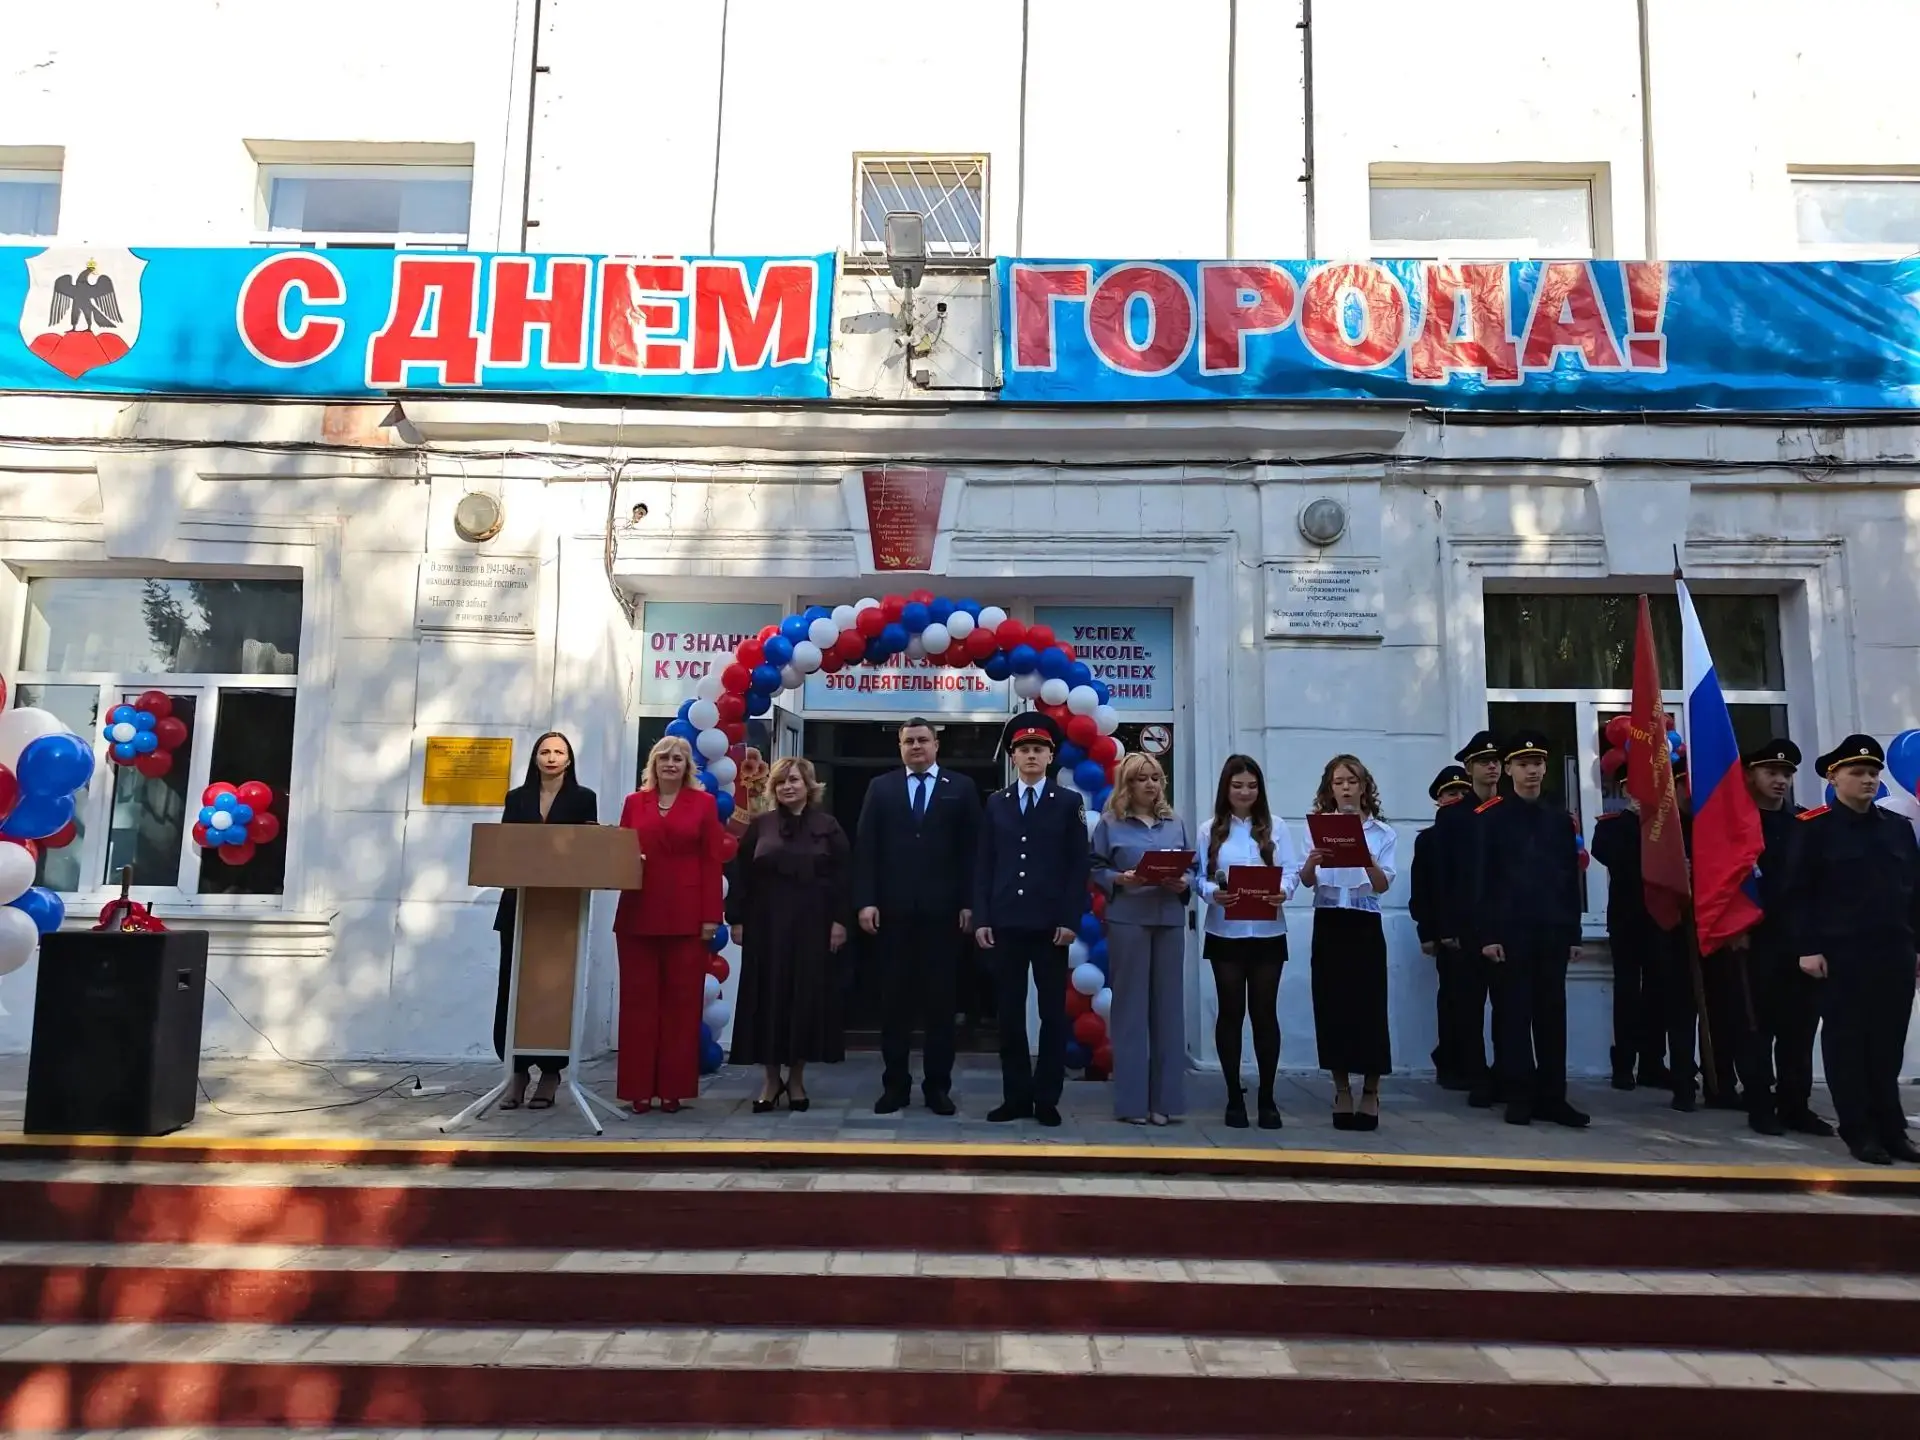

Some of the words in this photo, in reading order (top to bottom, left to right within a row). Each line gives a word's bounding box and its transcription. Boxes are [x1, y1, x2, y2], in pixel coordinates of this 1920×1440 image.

[236, 252, 347, 367] С
[1009, 259, 1669, 386] ГОРОДА!
[431, 561, 436, 572] В
[437, 564, 453, 573] этом
[480, 566, 485, 574] в
[462, 578, 492, 587] военный
[494, 581, 528, 589] госпиталь
[1298, 577, 1350, 585] Муниципальное
[1307, 595, 1347, 603] учреждение
[484, 614, 492, 622] не
[1073, 626, 1136, 641] УСПЕХ
[651, 632, 678, 652] ОТ
[683, 632, 757, 652] ЗНАН
[1074, 645, 1152, 660] ШКОЛЕ-
[655, 660, 670, 680] К
[1093, 664, 1156, 680] УСПЕХ
[826, 674, 856, 691] ЭТО
[858, 675, 991, 693] ДЕЯТЕЛЬНОСТЬ.
[1107, 684, 1152, 699] ЗНИ!
